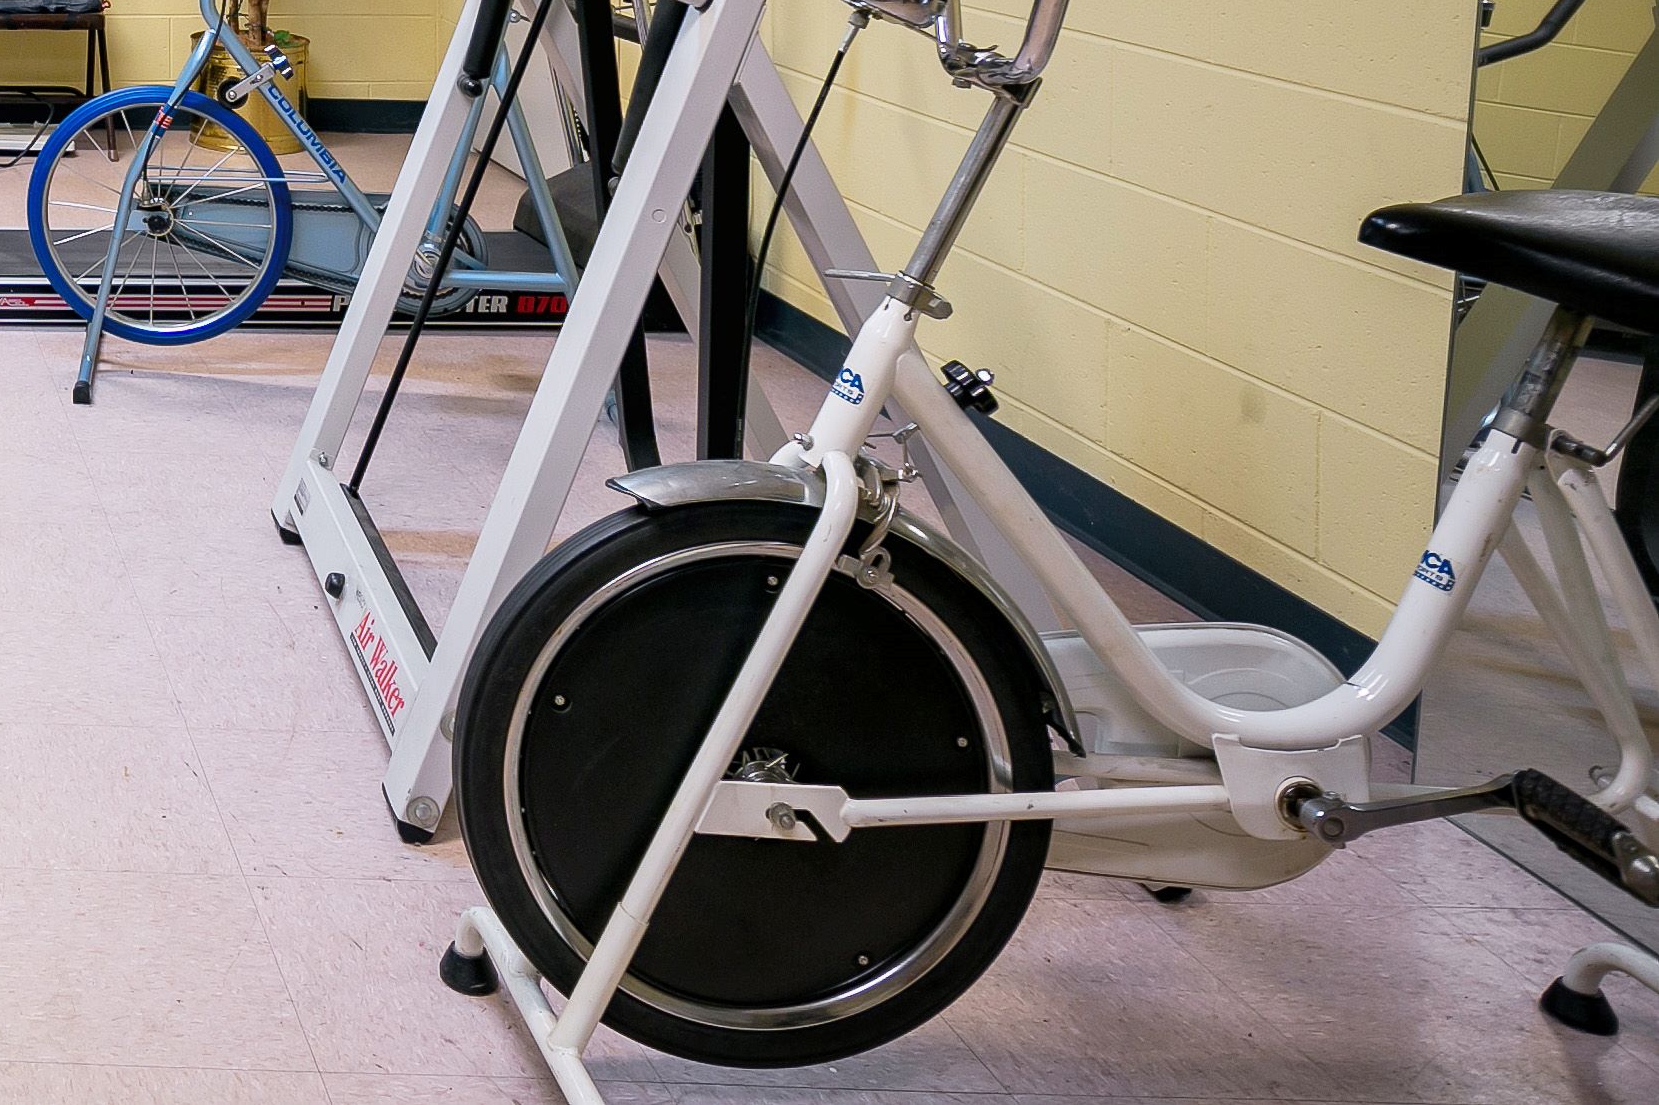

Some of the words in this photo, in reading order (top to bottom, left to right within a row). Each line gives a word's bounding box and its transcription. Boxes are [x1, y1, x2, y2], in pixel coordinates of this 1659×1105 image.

[267, 85, 347, 184] COLUMBIA
[355, 612, 375, 651] Air
[369, 635, 405, 718] Walker
